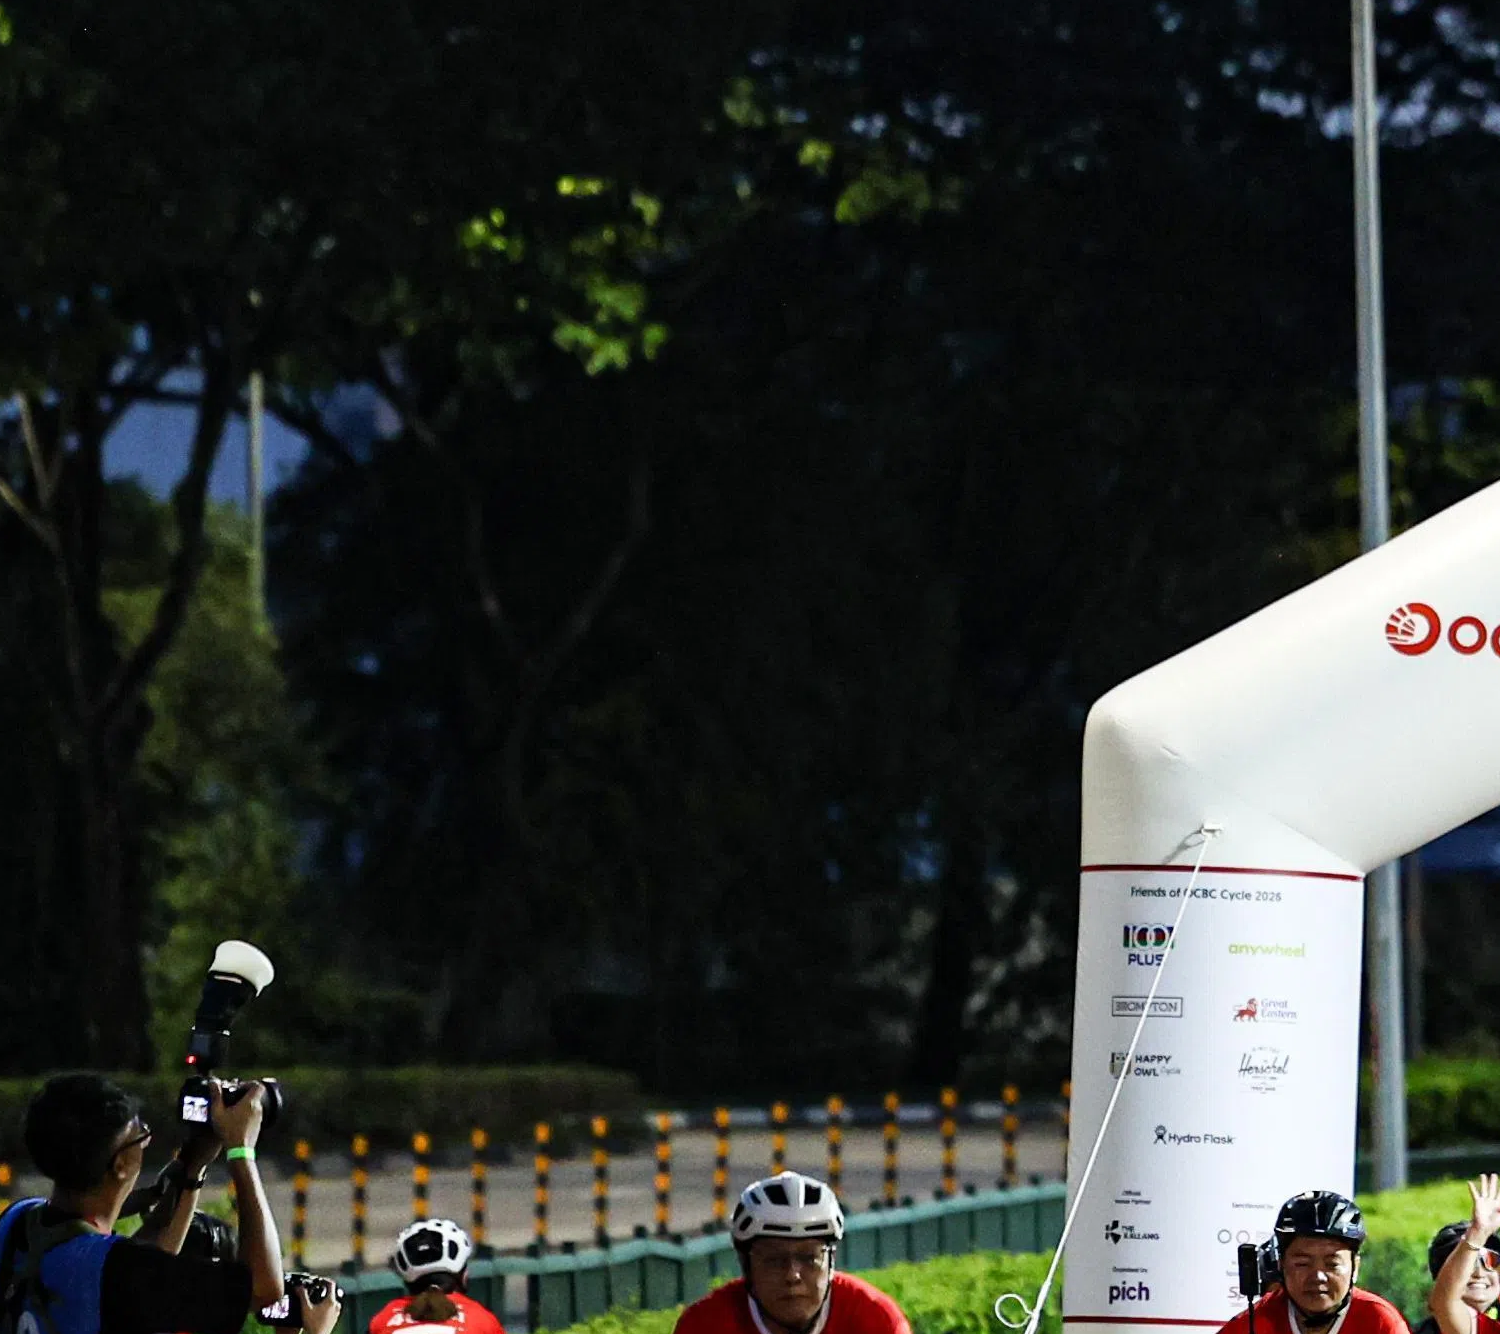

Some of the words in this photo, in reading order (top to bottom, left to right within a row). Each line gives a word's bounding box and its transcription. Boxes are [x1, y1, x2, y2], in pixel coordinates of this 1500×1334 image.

[1130, 886, 1166, 898] Friends
[1169, 887, 1181, 898] of
[1183, 887, 1217, 899] OCBC
[1220, 889, 1252, 902] Cycle
[1228, 942, 1307, 958] anywheel
[1127, 953, 1166, 967] PLUS
[1114, 1001, 1178, 1013] BROMTON
[1260, 998, 1289, 1009] Great
[1261, 1009, 1298, 1020] Eastern
[1134, 1054, 1173, 1065] HAPPY
[1133, 1067, 1160, 1077] OWL
[1168, 1133, 1201, 1146] Hydro
[1203, 1134, 1235, 1145] Flask
[1108, 1280, 1151, 1305] pich
